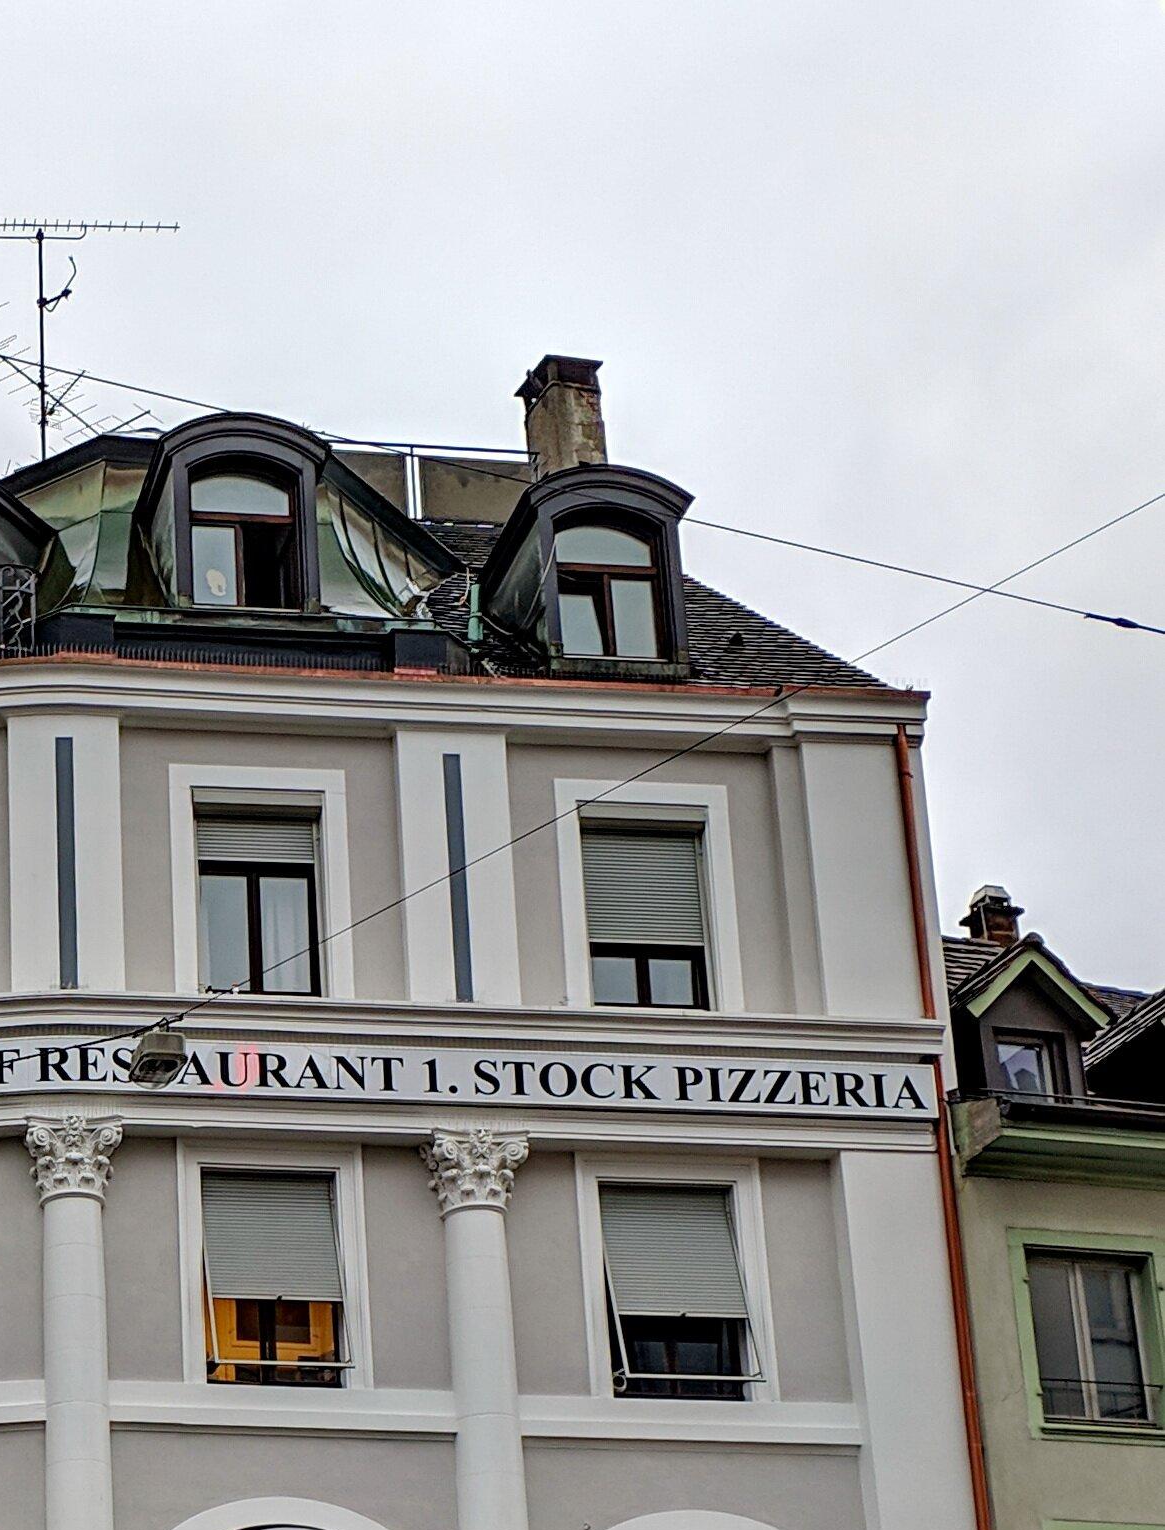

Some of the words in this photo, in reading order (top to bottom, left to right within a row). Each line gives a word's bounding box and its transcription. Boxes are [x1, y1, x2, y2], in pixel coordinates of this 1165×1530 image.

[35, 1047, 404, 1092] RESAURANT
[421, 1058, 458, 1094] 1.
[474, 1059, 661, 1100] STOCK
[673, 1066, 928, 1110] PIZZERIA
